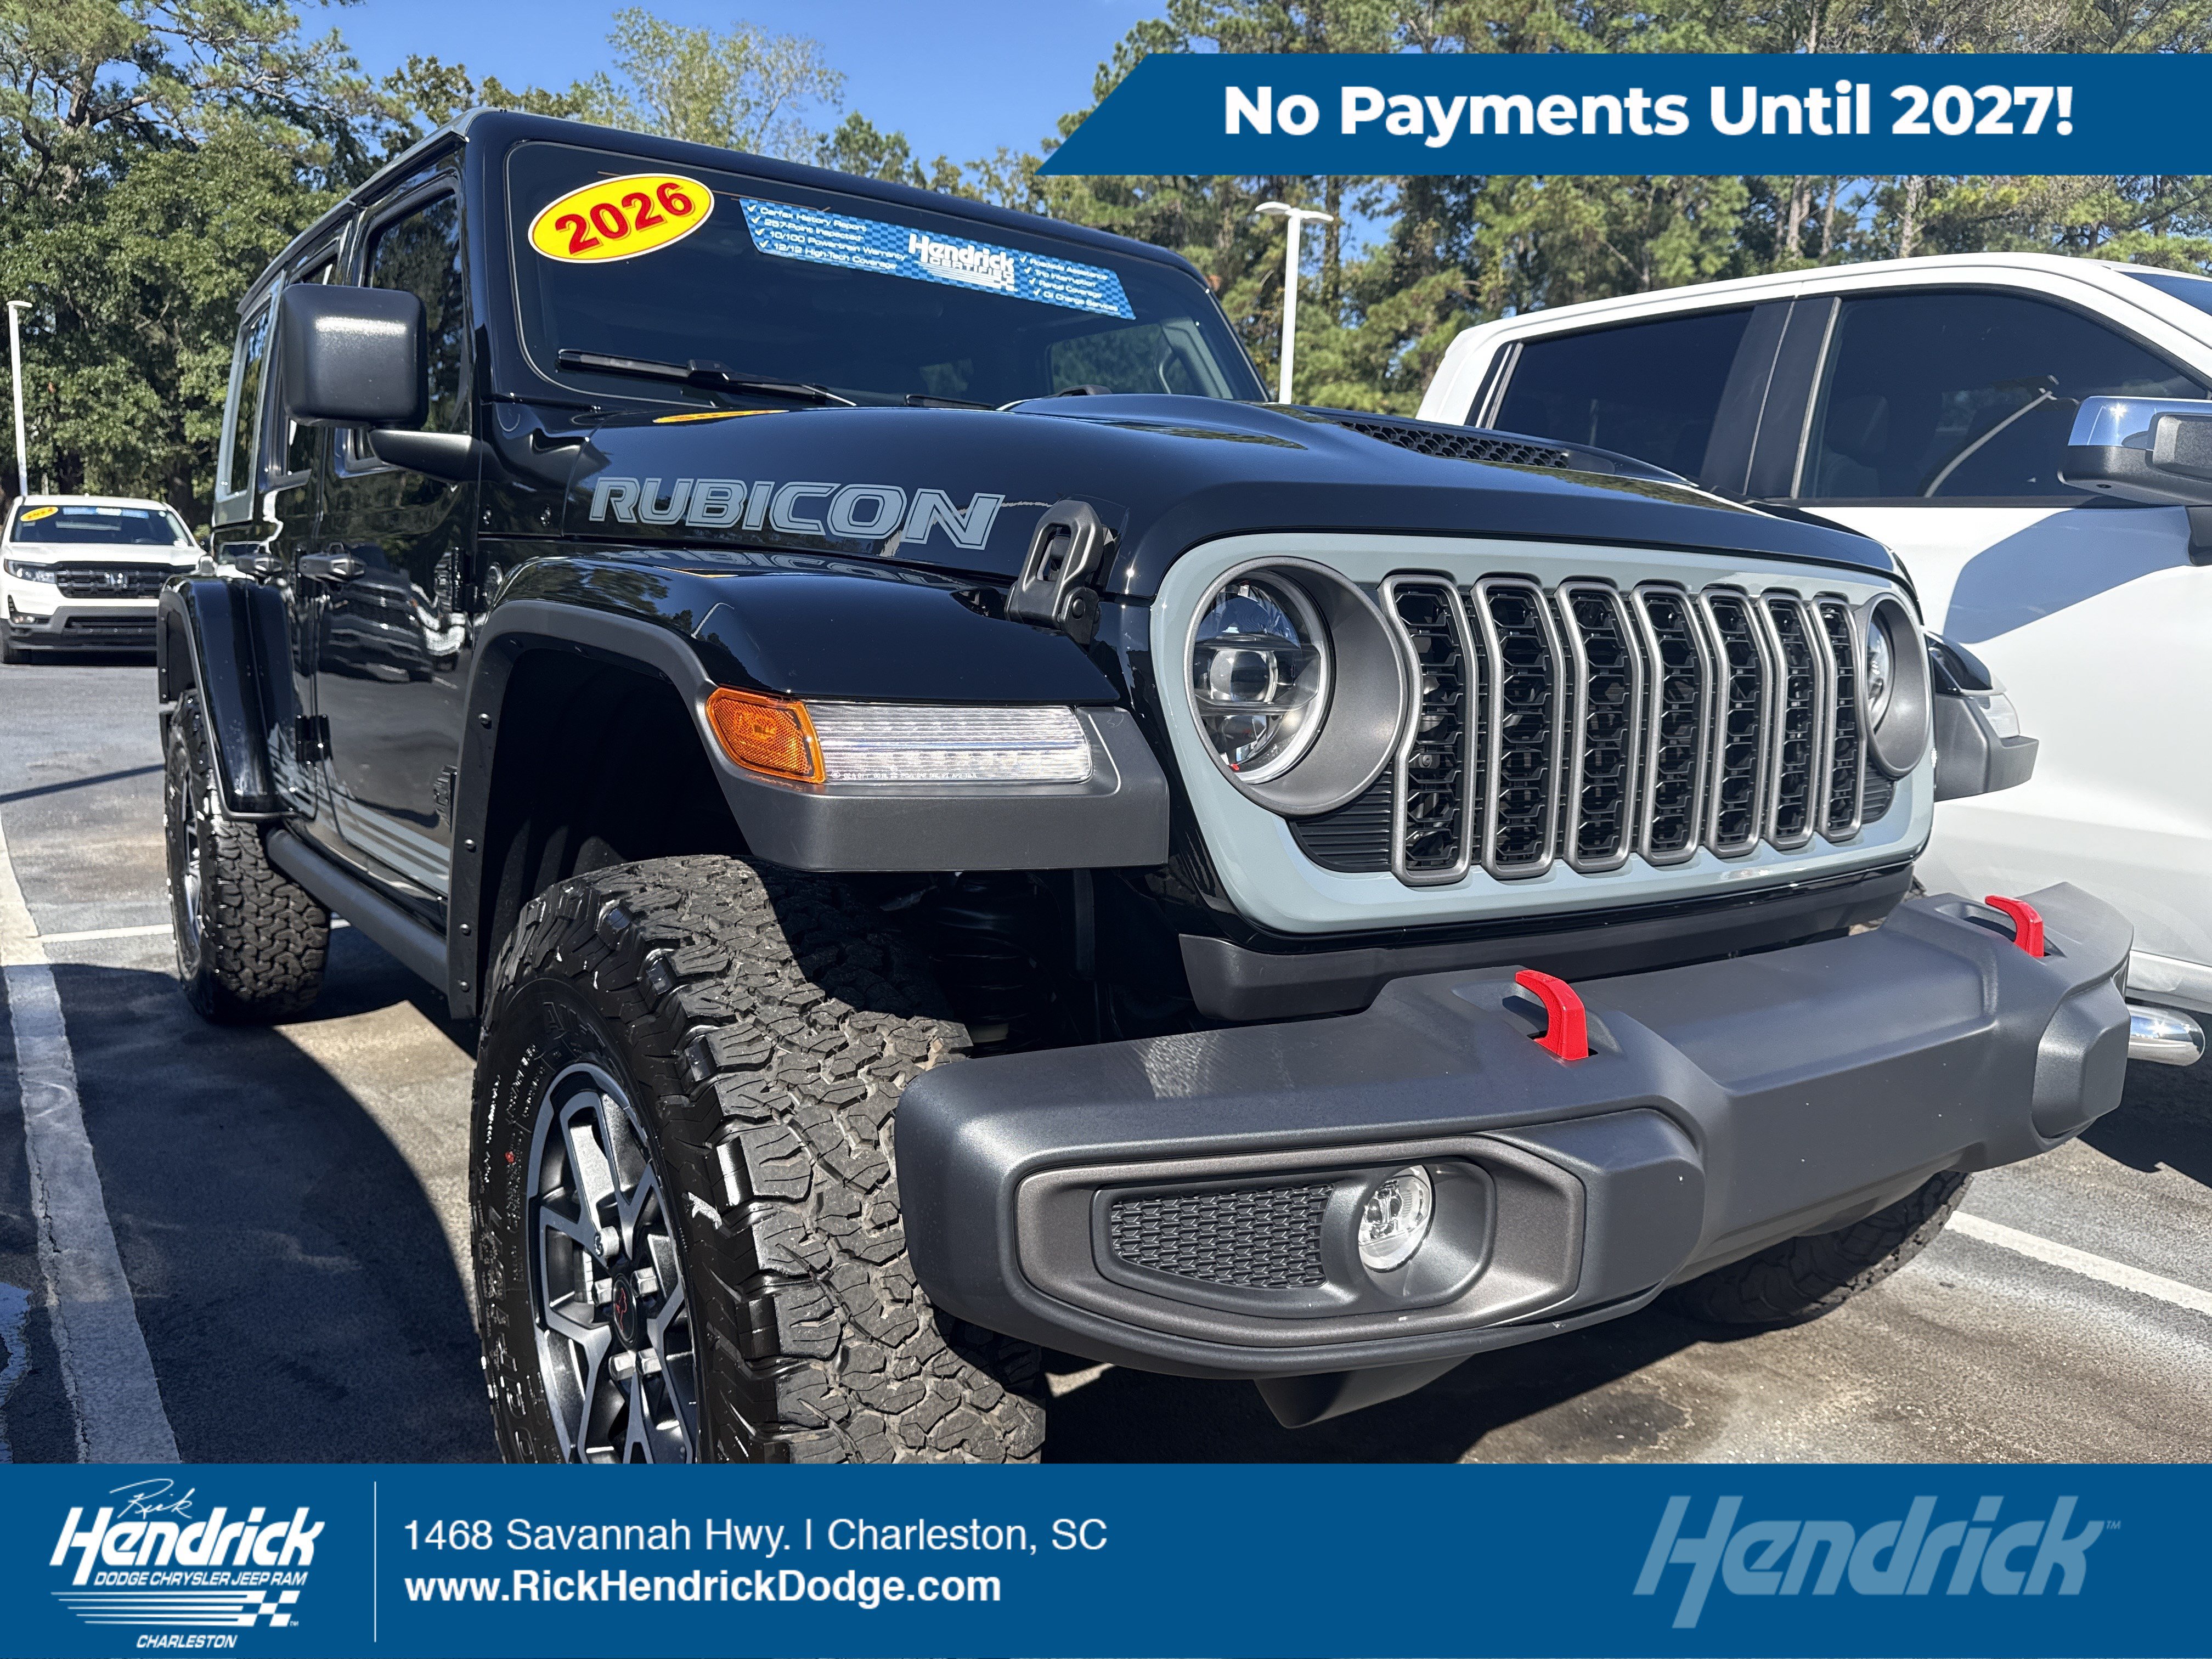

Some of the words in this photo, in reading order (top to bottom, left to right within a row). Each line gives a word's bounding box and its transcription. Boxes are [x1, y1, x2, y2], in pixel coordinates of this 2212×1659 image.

[555, 182, 693, 255] 2026
[760, 207, 793, 219] Carfax
[797, 212, 832, 227] History
[834, 219, 867, 232] Report
[770, 230, 805, 243] 10/100
[808, 236, 860, 252] Powertrain
[774, 242, 803, 254] 12/12
[805, 247, 850, 262] High-Tech
[909, 233, 1015, 273] Hendrick
[929, 256, 1014, 280] CERTIFIED
[589, 477, 1006, 550] RUBICON
